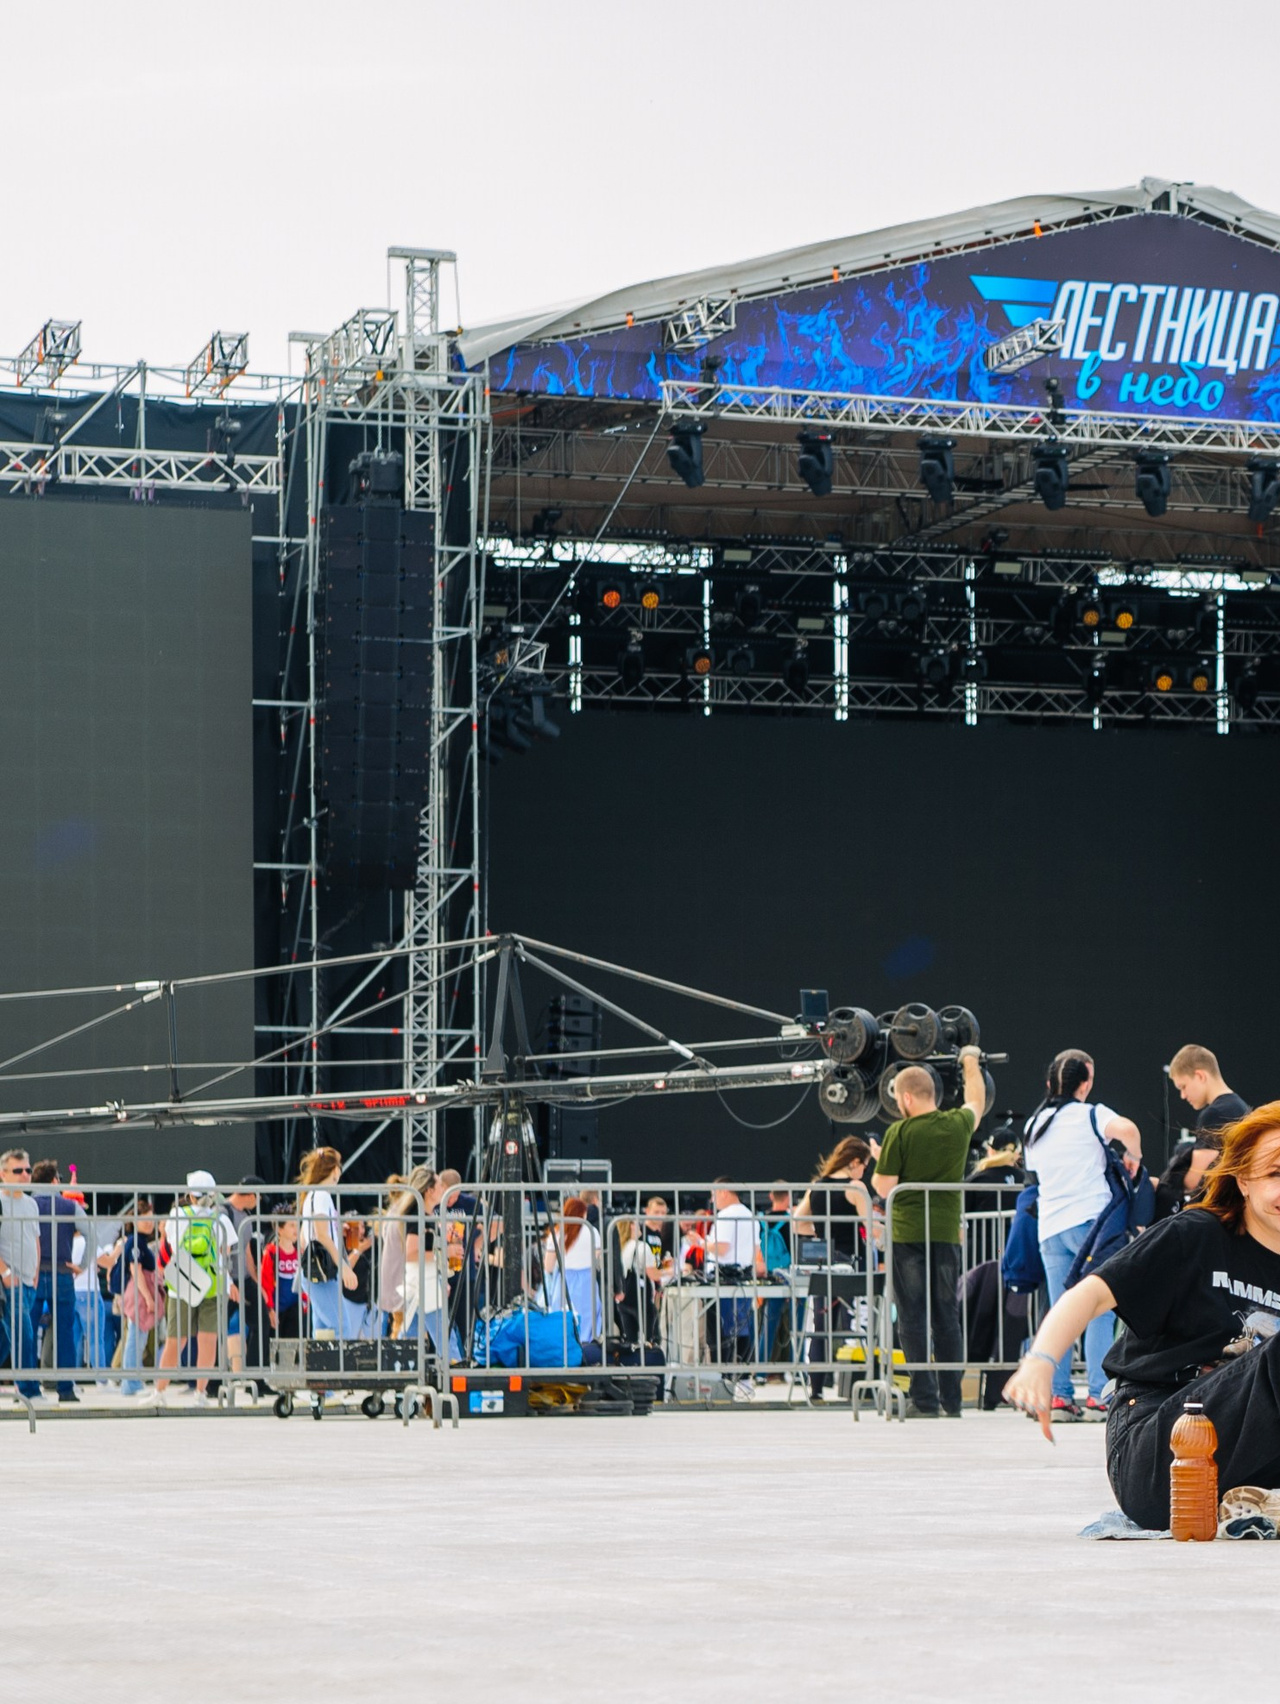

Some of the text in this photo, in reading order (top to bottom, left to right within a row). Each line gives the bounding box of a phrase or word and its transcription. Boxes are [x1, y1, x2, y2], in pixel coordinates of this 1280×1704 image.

[1050, 280, 1280, 375] ЛЕСТНИЦА
[1077, 350, 1226, 412] в небо
